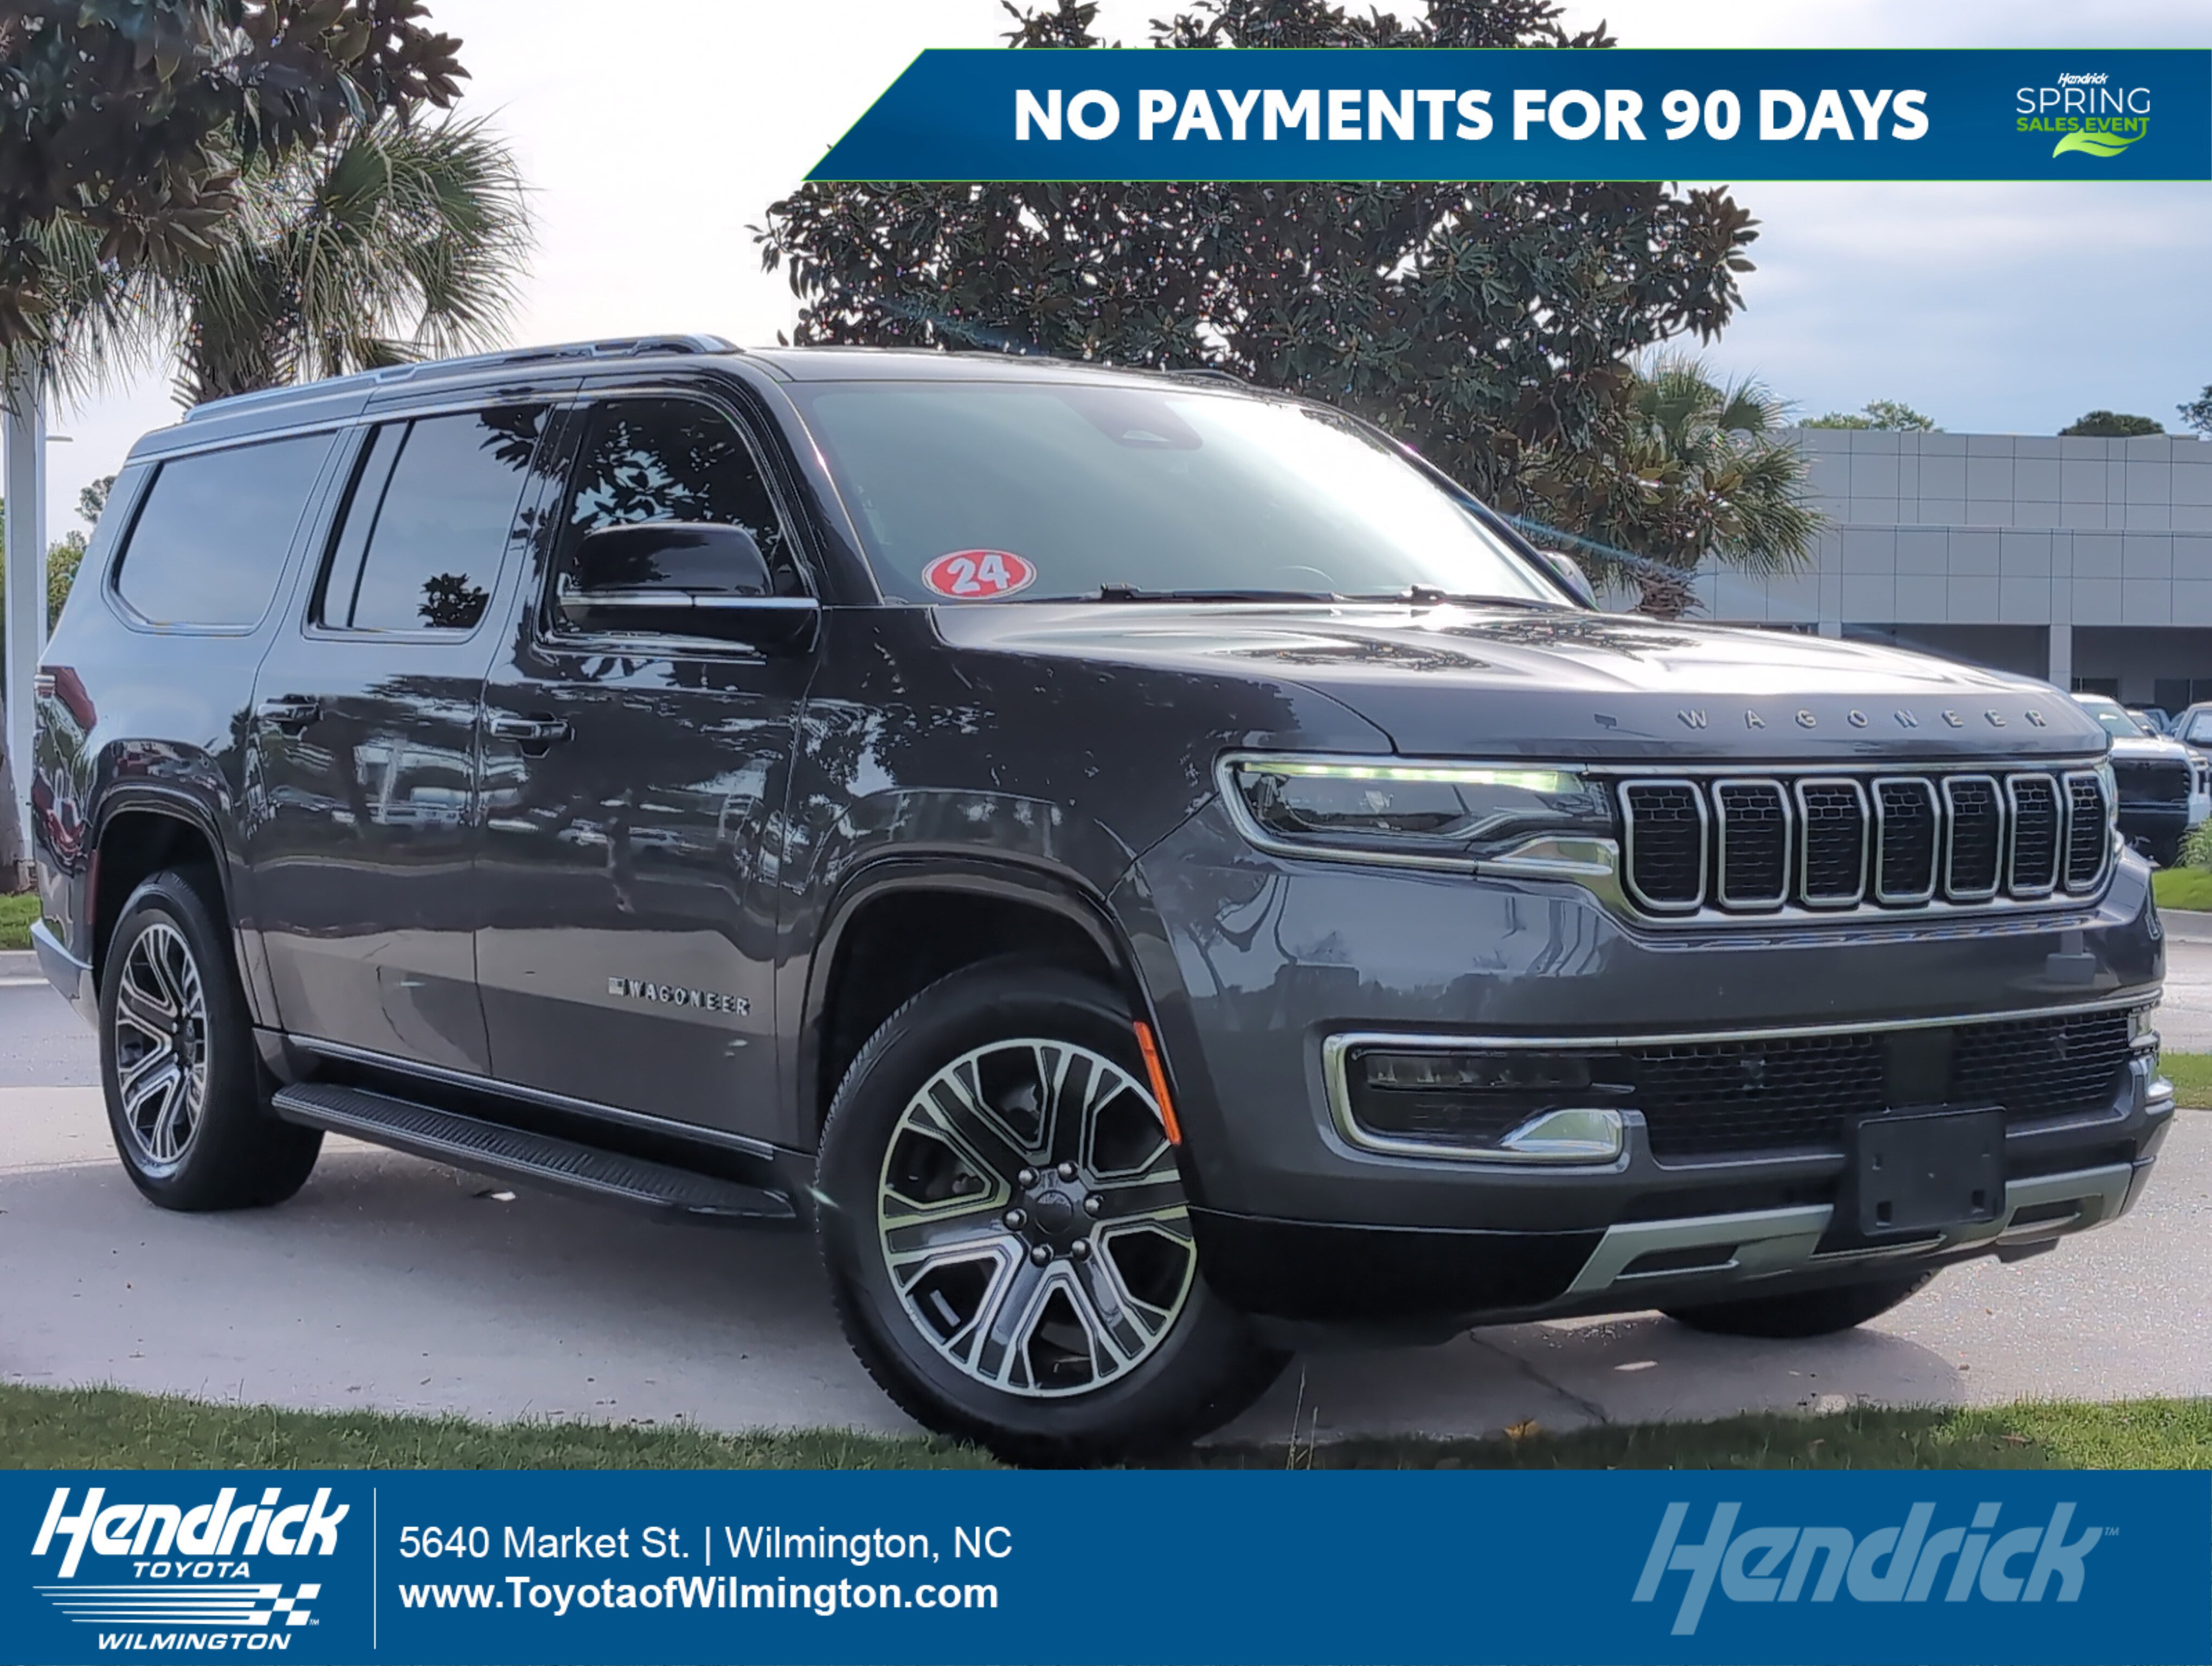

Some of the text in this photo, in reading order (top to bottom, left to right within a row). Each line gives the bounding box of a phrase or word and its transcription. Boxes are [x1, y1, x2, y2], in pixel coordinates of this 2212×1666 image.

[947, 554, 1011, 594] 24
[1677, 709, 2047, 729] WAGONEER
[629, 979, 750, 1016] WAGONEER
